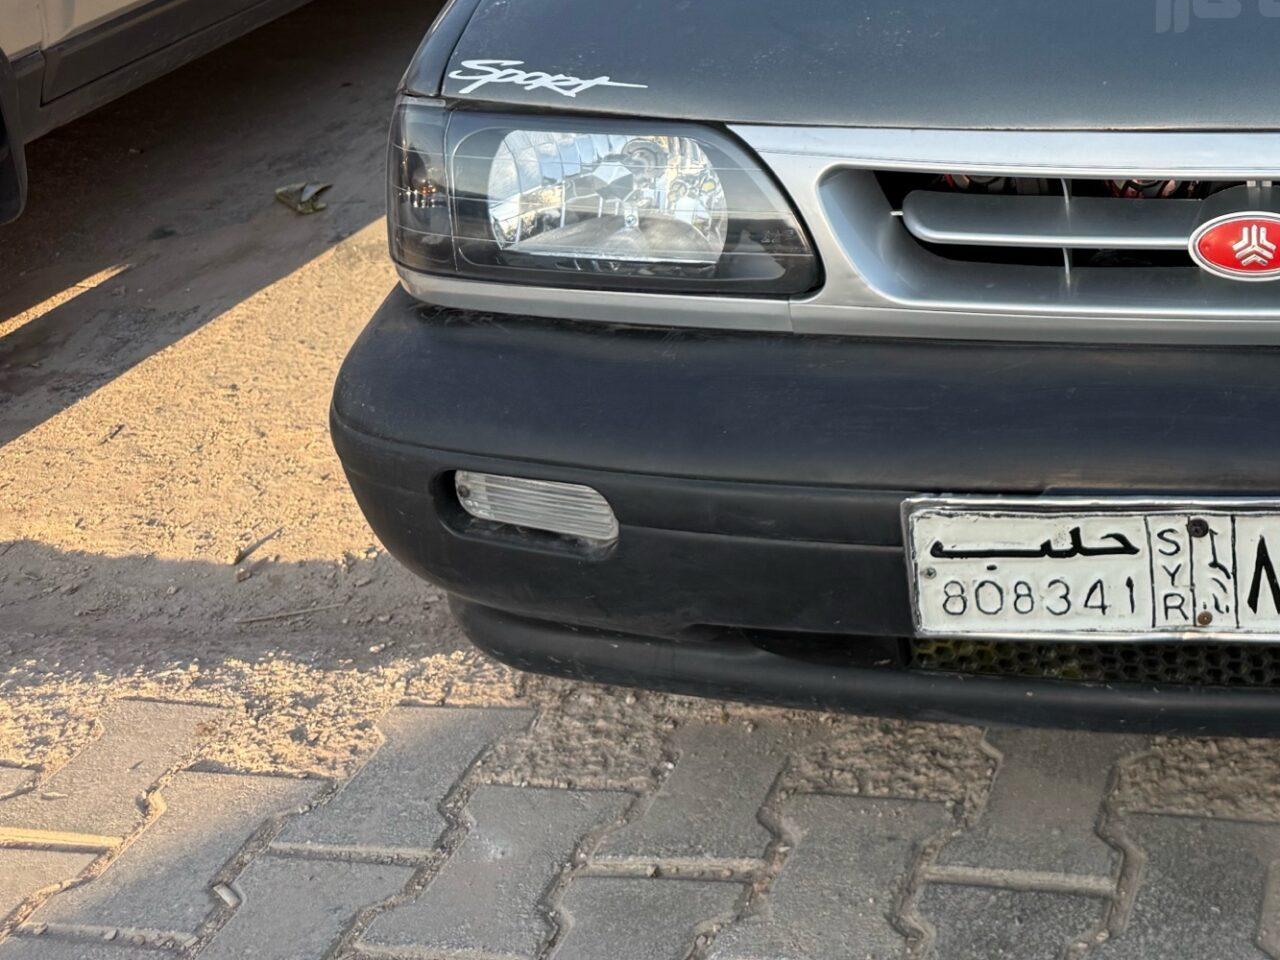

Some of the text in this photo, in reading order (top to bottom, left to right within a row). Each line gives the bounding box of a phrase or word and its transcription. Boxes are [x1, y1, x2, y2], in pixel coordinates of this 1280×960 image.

[448, 59, 649, 98] Sport
[930, 526, 1140, 572] حلب
[942, 576, 1136, 616] 808341
